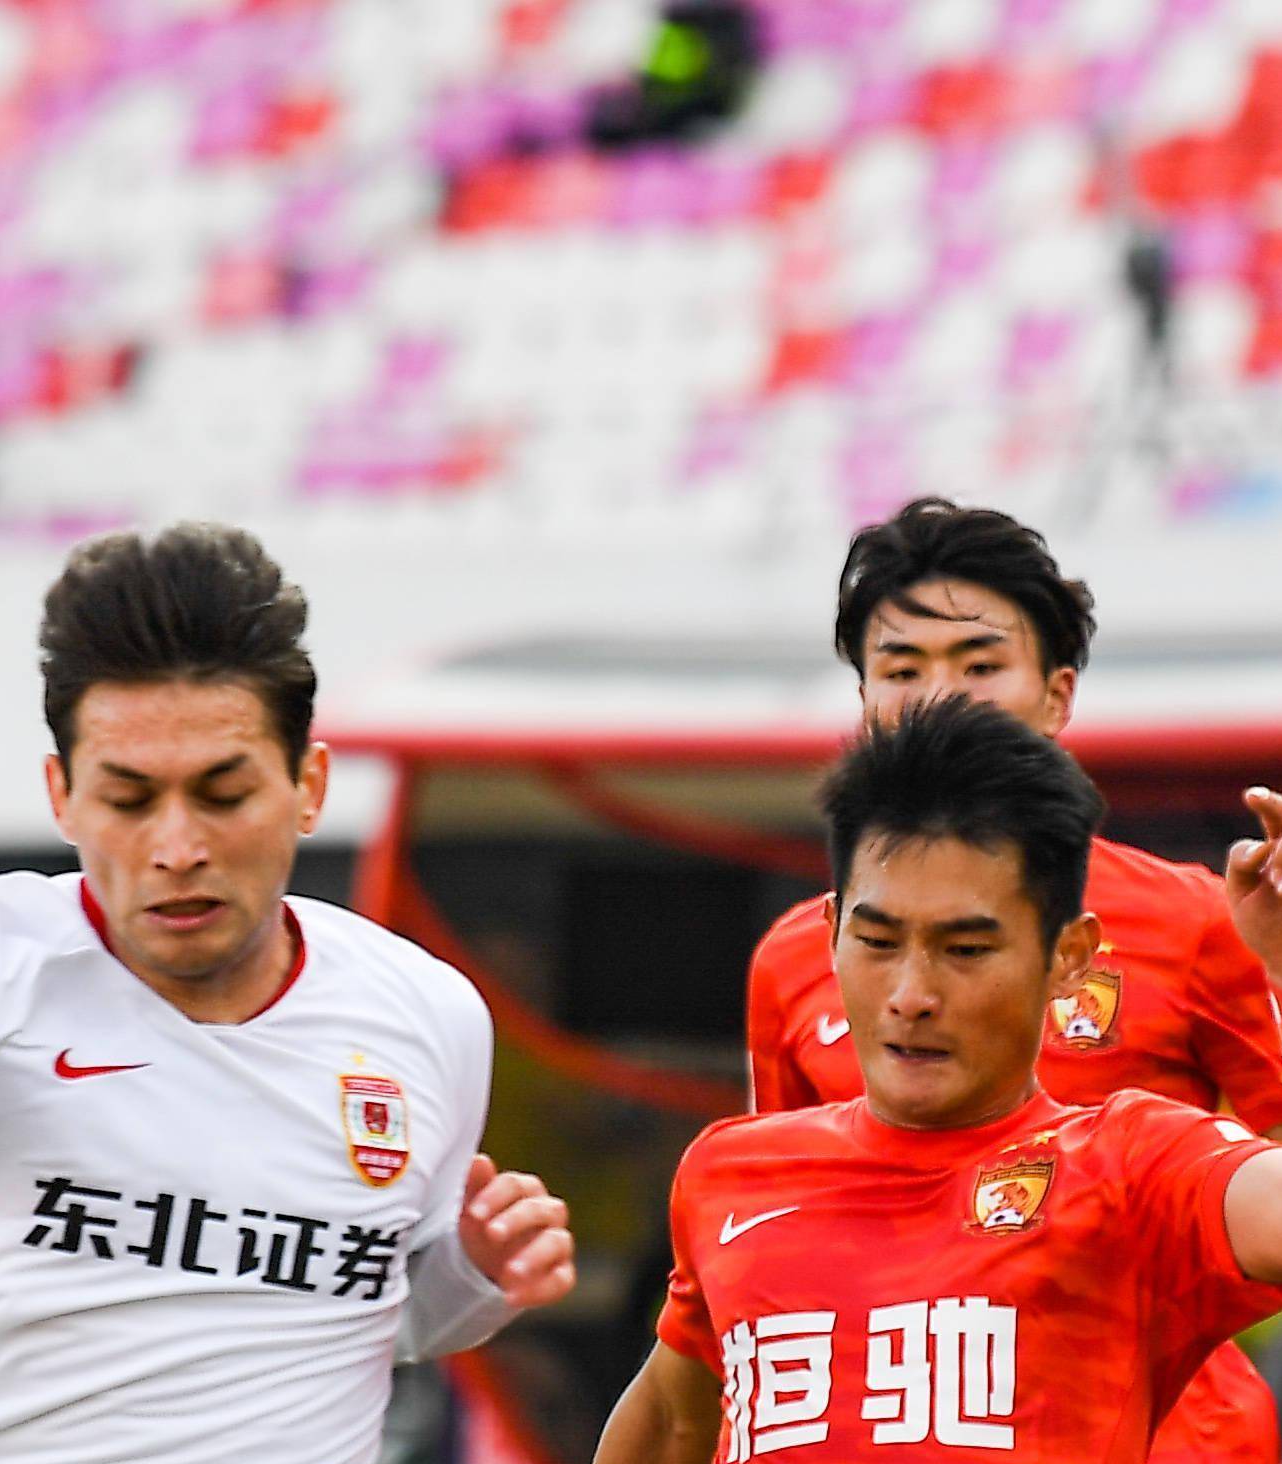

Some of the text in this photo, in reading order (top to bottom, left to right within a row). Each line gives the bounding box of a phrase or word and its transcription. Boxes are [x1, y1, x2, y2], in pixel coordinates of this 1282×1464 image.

[22, 1176, 401, 1300] 东北证券
[721, 1296, 1017, 1464] 恒驰
